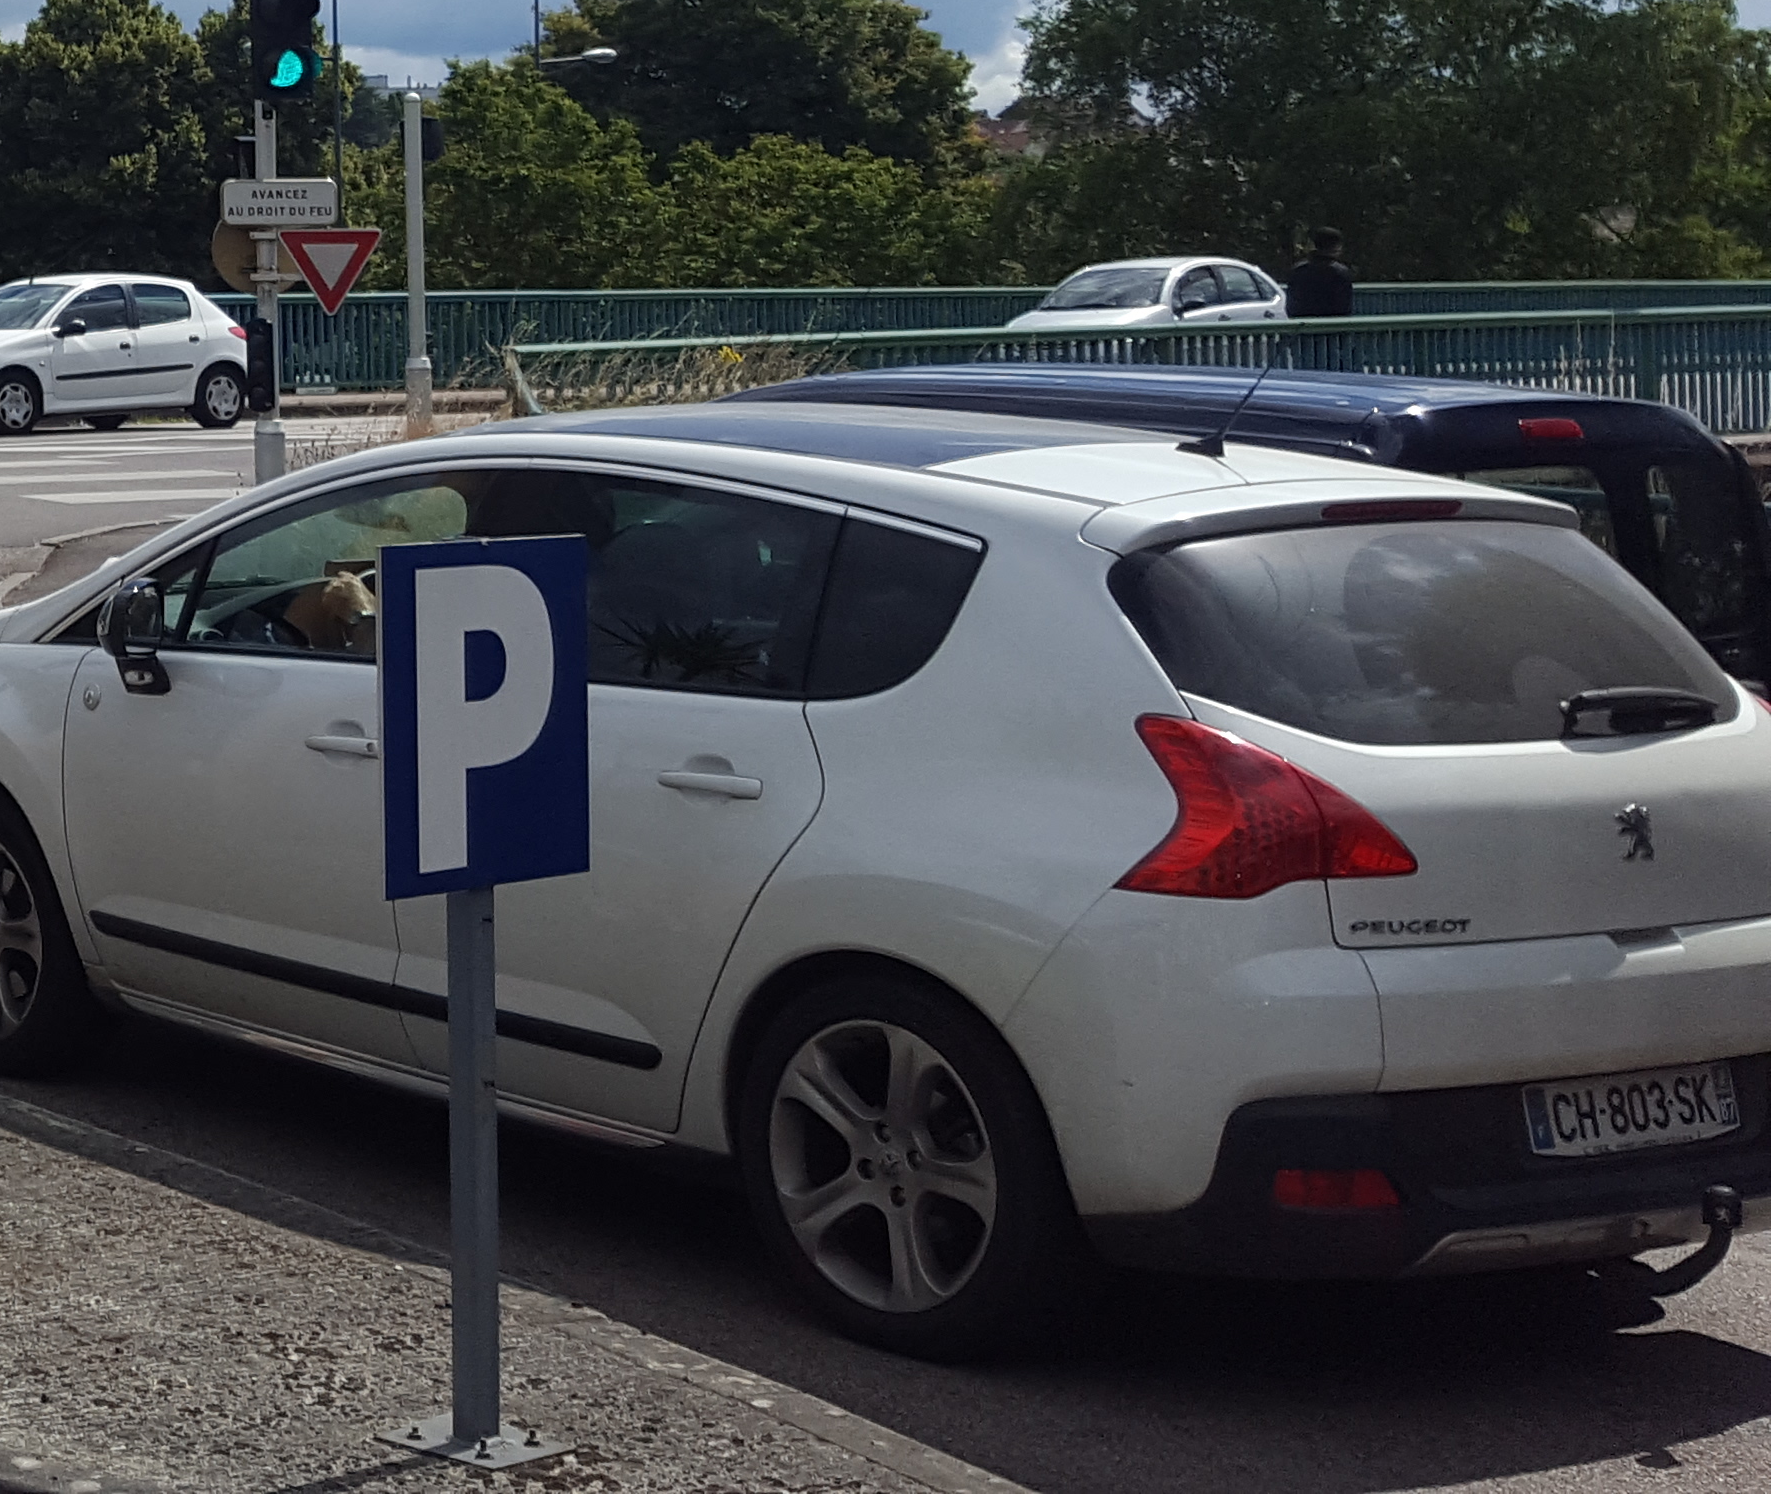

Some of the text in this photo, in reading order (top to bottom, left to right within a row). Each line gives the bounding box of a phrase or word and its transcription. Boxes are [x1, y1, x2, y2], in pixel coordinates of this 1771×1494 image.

[251, 189, 308, 200] AVANCEZ
[227, 206, 333, 217] AU DROIT DU FEU
[414, 563, 556, 875] P
[1349, 917, 1472, 935] PEUGEOT
